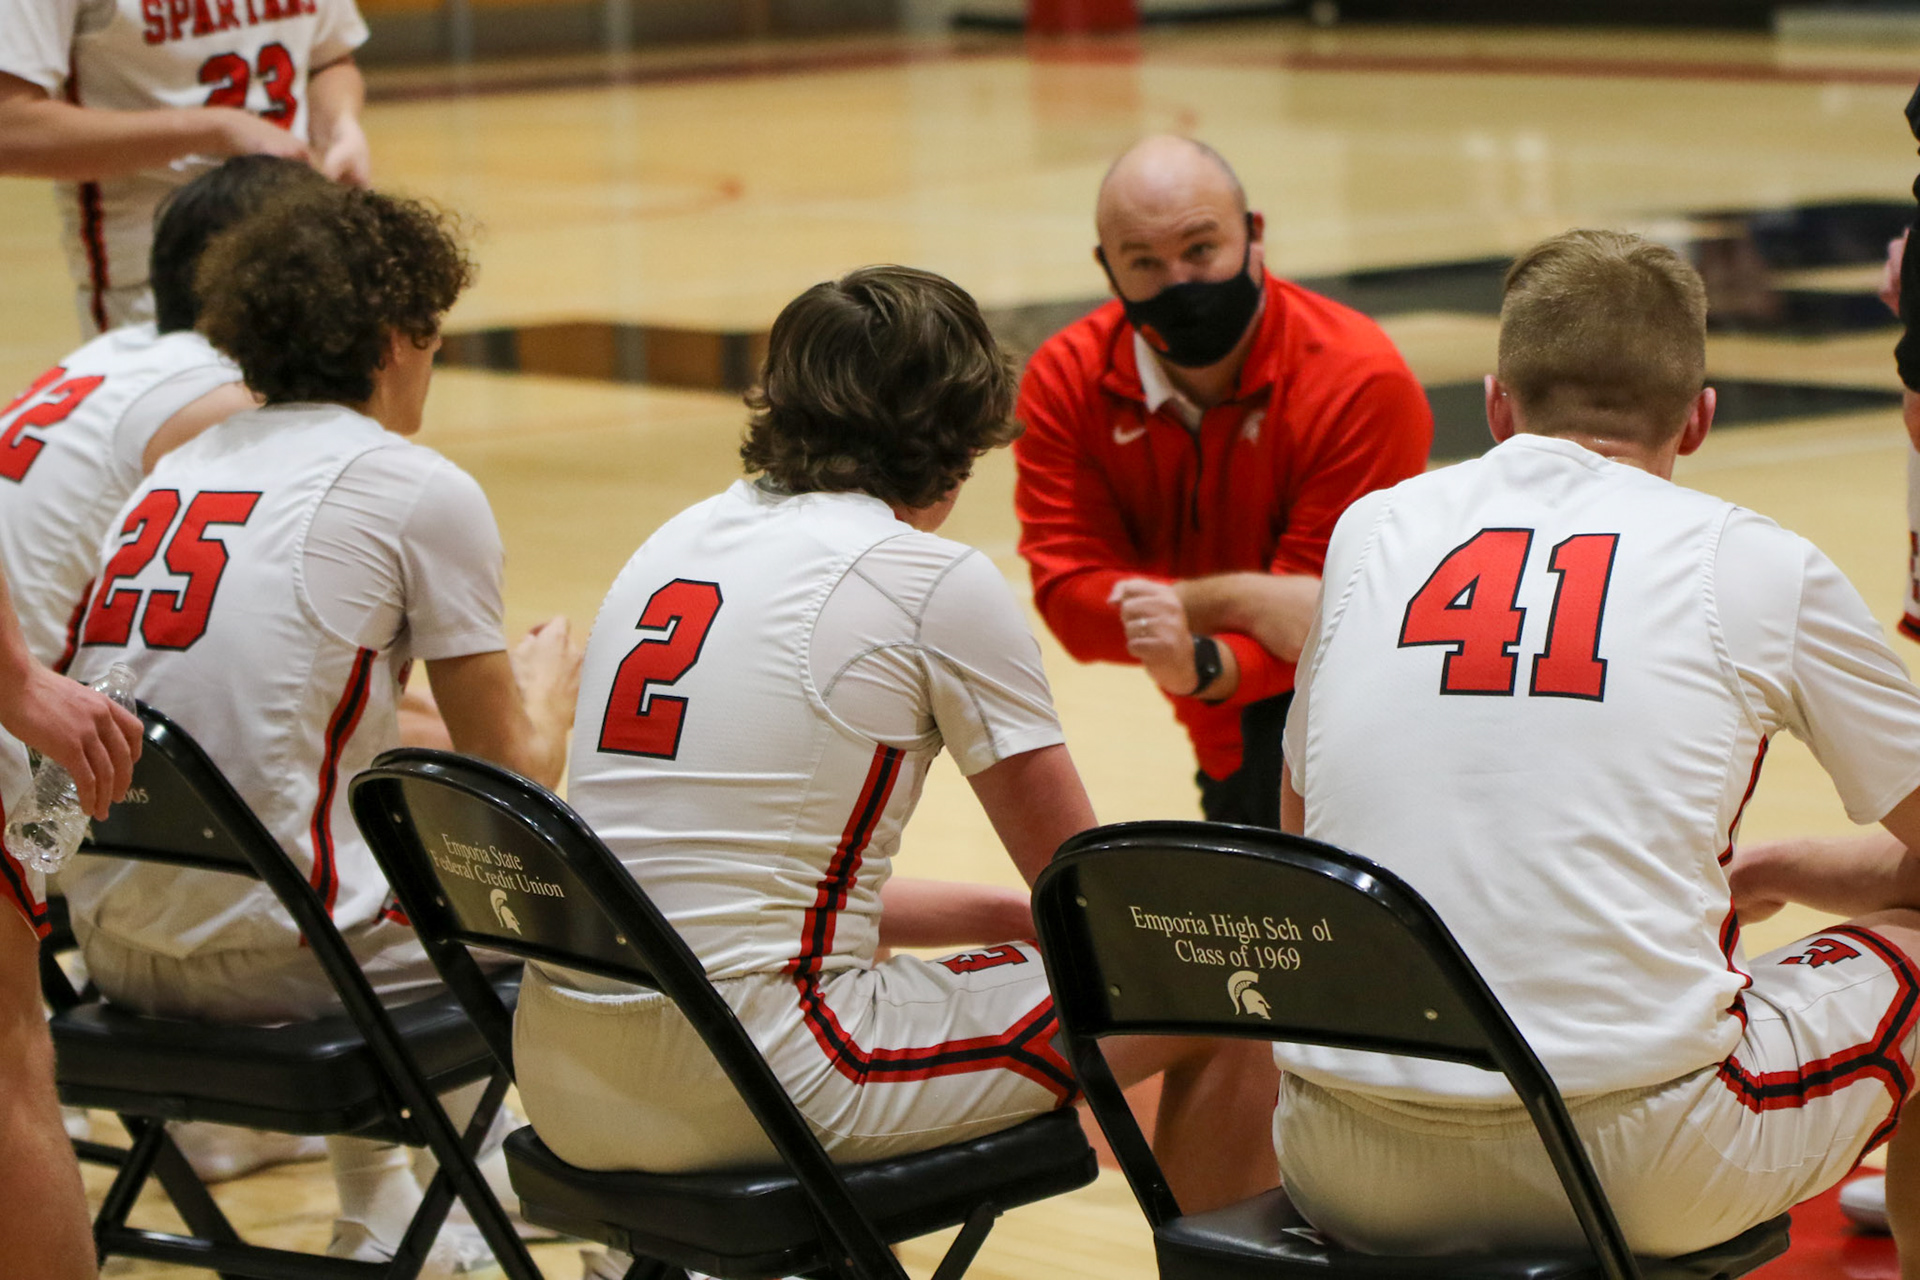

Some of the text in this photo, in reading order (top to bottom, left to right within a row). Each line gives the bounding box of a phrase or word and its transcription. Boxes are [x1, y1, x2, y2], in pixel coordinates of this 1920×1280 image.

[198, 41, 298, 131] 23
[81, 489, 263, 651] 25
[1398, 528, 1620, 702] 41
[597, 578, 723, 760] 2
[430, 850, 565, 898] Federal Credit Union
[441, 833, 523, 871] Emporia State
[1129, 906, 1209, 937] Emporia
[1210, 914, 1260, 944] High
[1175, 939, 1301, 970] Class of 1969
